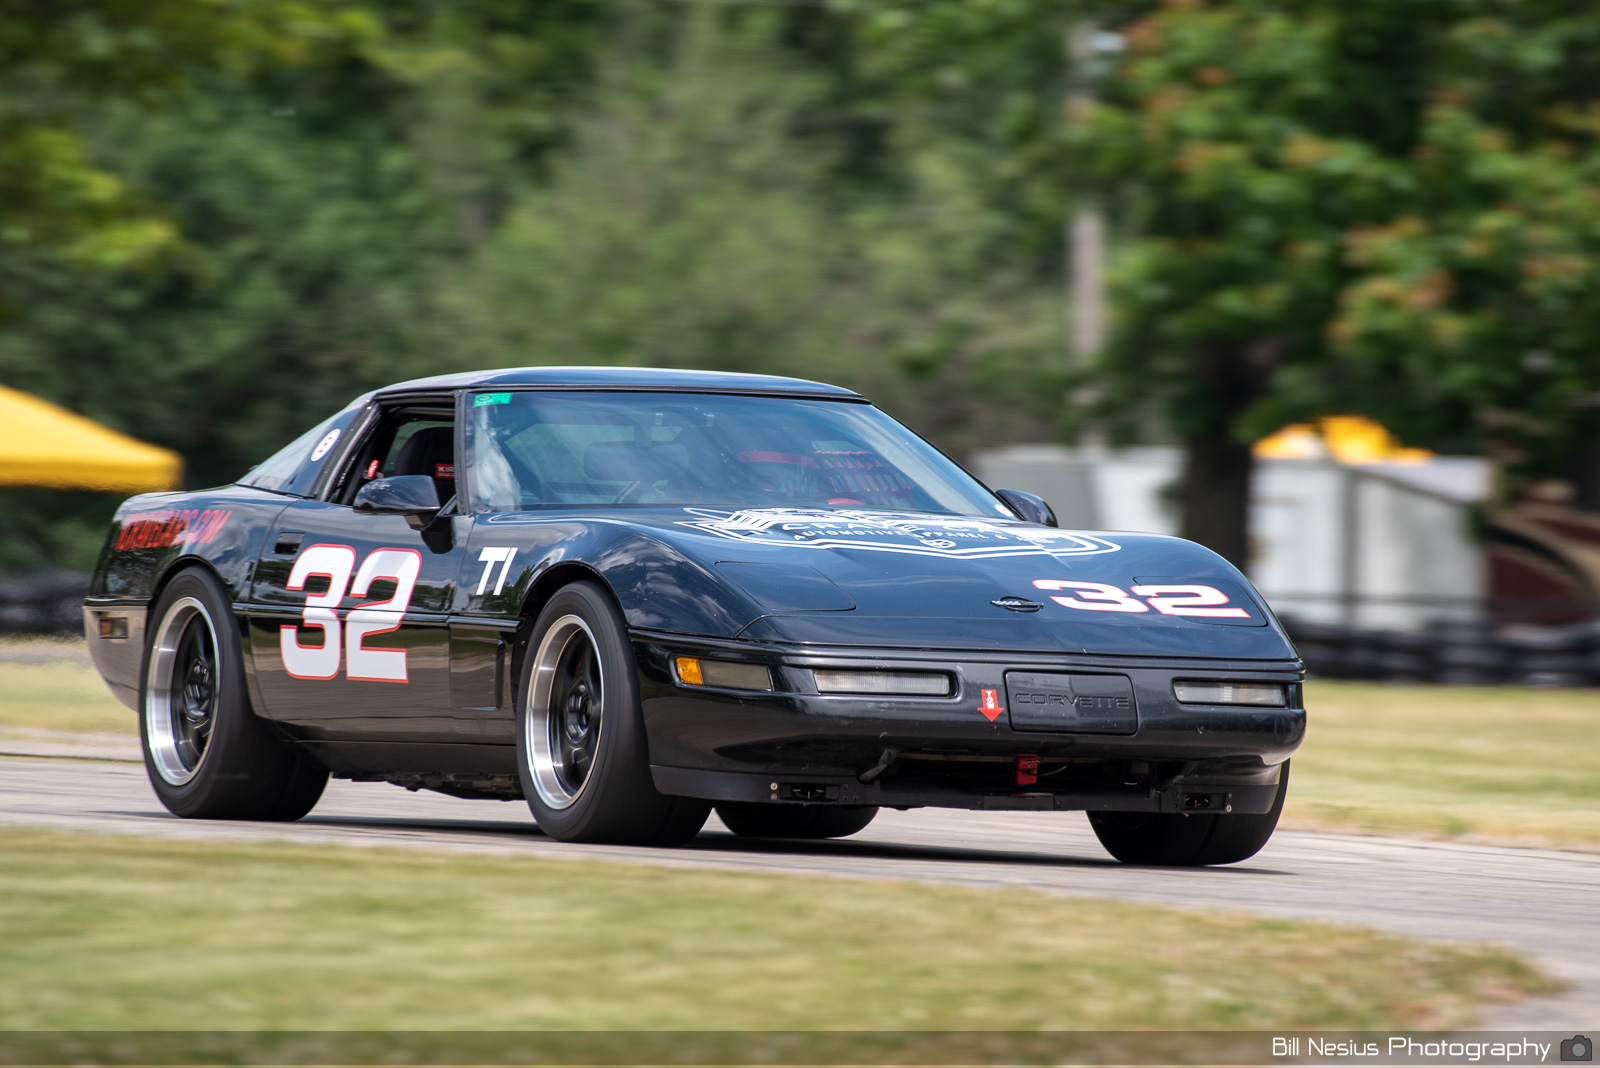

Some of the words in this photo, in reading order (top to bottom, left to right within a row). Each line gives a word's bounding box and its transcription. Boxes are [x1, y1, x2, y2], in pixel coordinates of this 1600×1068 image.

[793, 530, 907, 541] AUTOMOTIVE
[1032, 579, 1252, 618] 32
[280, 543, 422, 684] 32
[985, 690, 995, 709] TOW
[1015, 693, 1130, 709] CORVETTE
